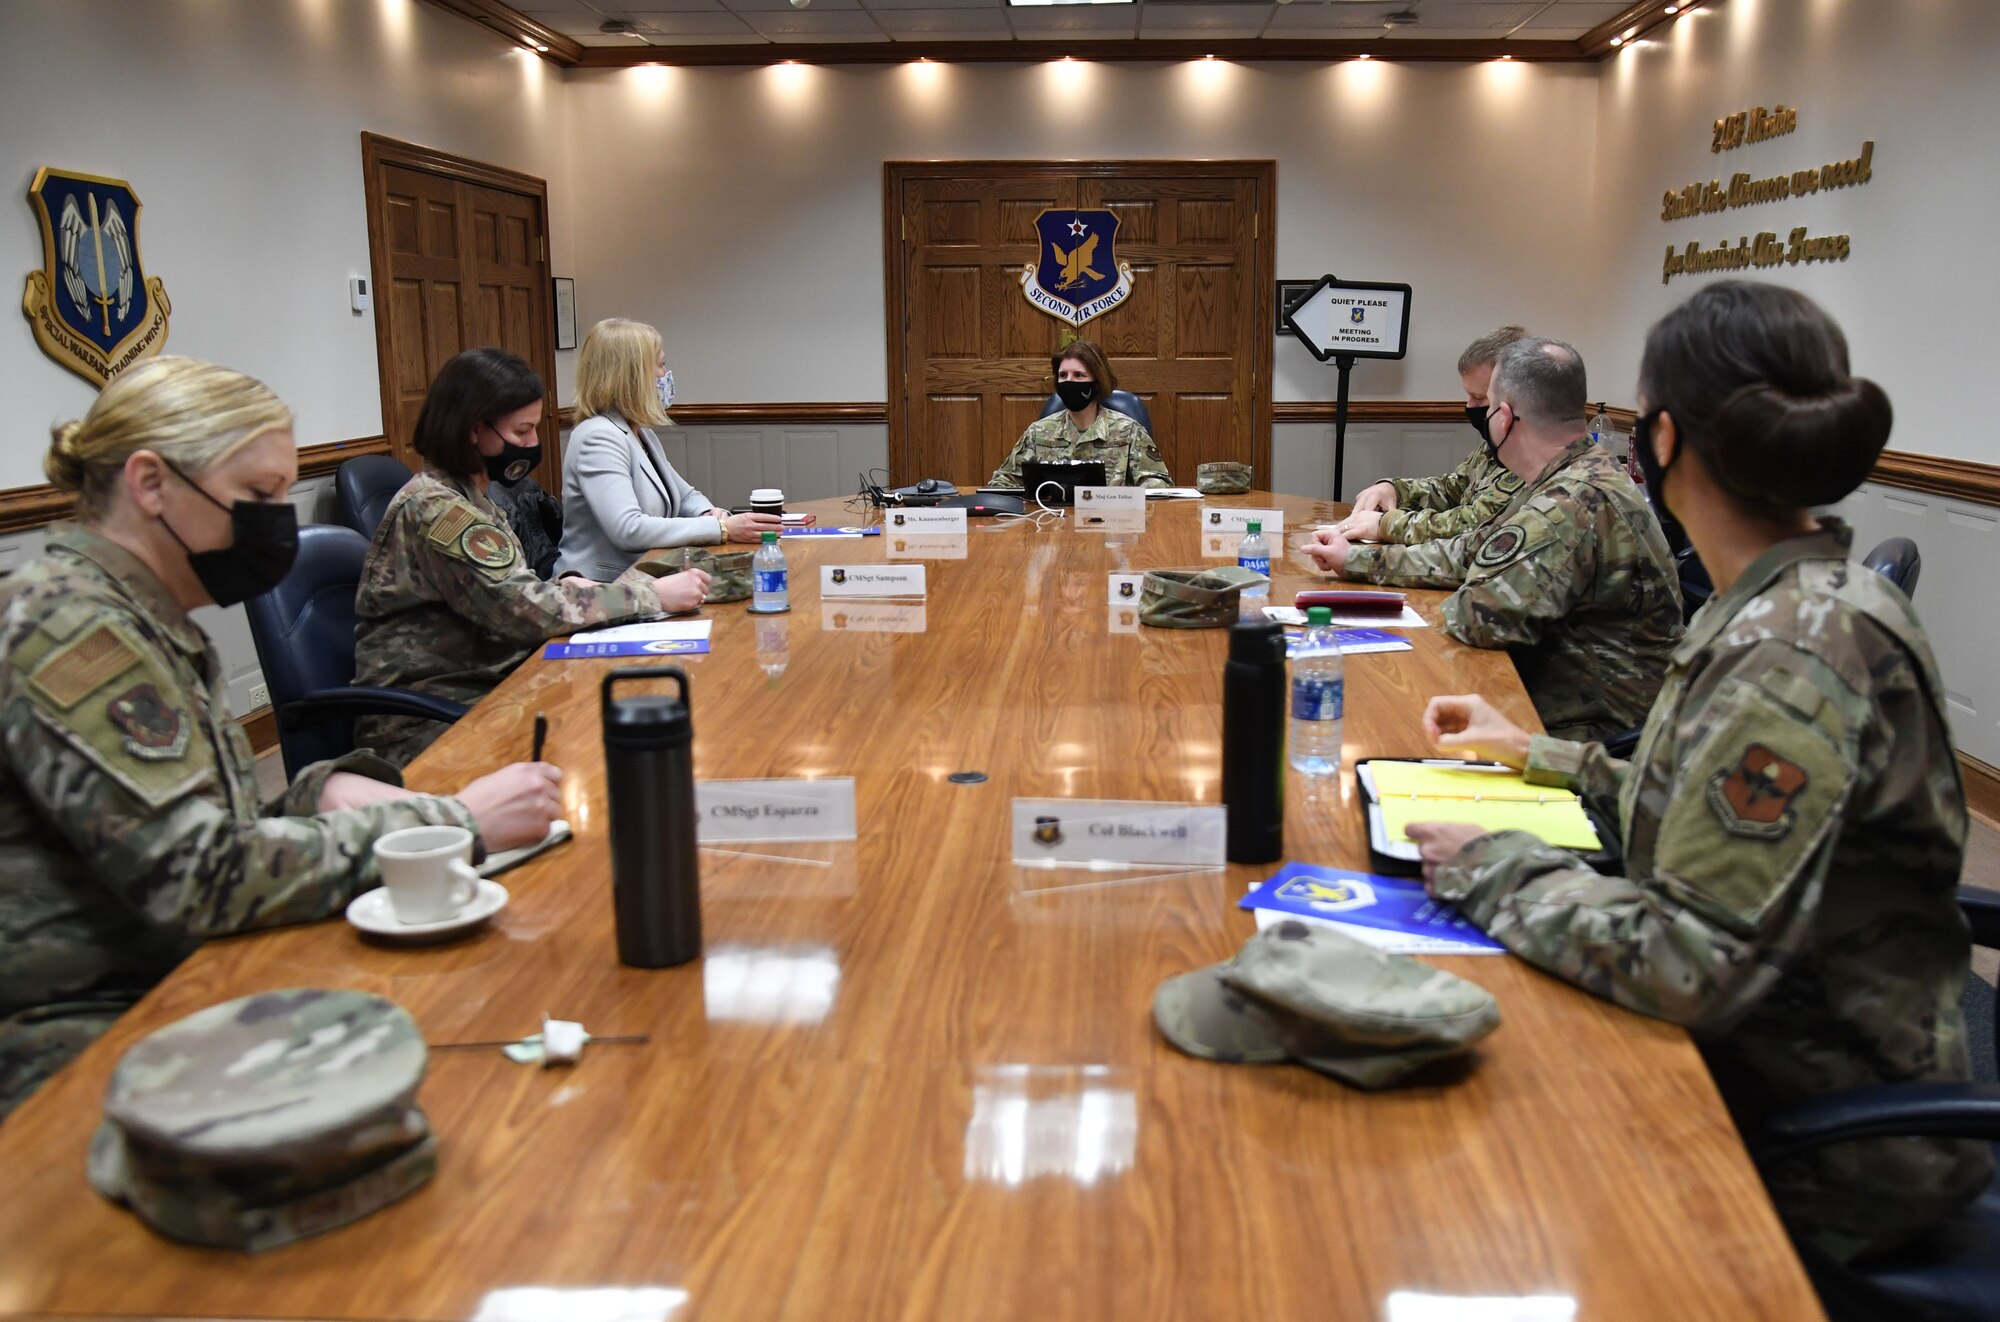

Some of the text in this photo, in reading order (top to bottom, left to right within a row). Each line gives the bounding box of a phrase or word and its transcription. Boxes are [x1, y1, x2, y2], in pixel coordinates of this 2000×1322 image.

[1744, 104, 1797, 146] Mission
[1661, 140, 1875, 222] Build the Airmen we need
[1662, 226, 1850, 286] for America's Air Force
[1029, 287, 1126, 321] SECOND AIR FORCE
[1331, 298, 1388, 308] QUIET PLEASE
[1338, 328, 1372, 336] MEETING
[1341, 336, 1380, 344] PROGRESS
[40, 304, 163, 380] SPECIAL WARFARE TRAINING WING
[848, 573, 908, 584] CMSgt Sampson
[711, 804, 820, 821] CMSgt Esparza
[1088, 823, 1114, 837] Col
